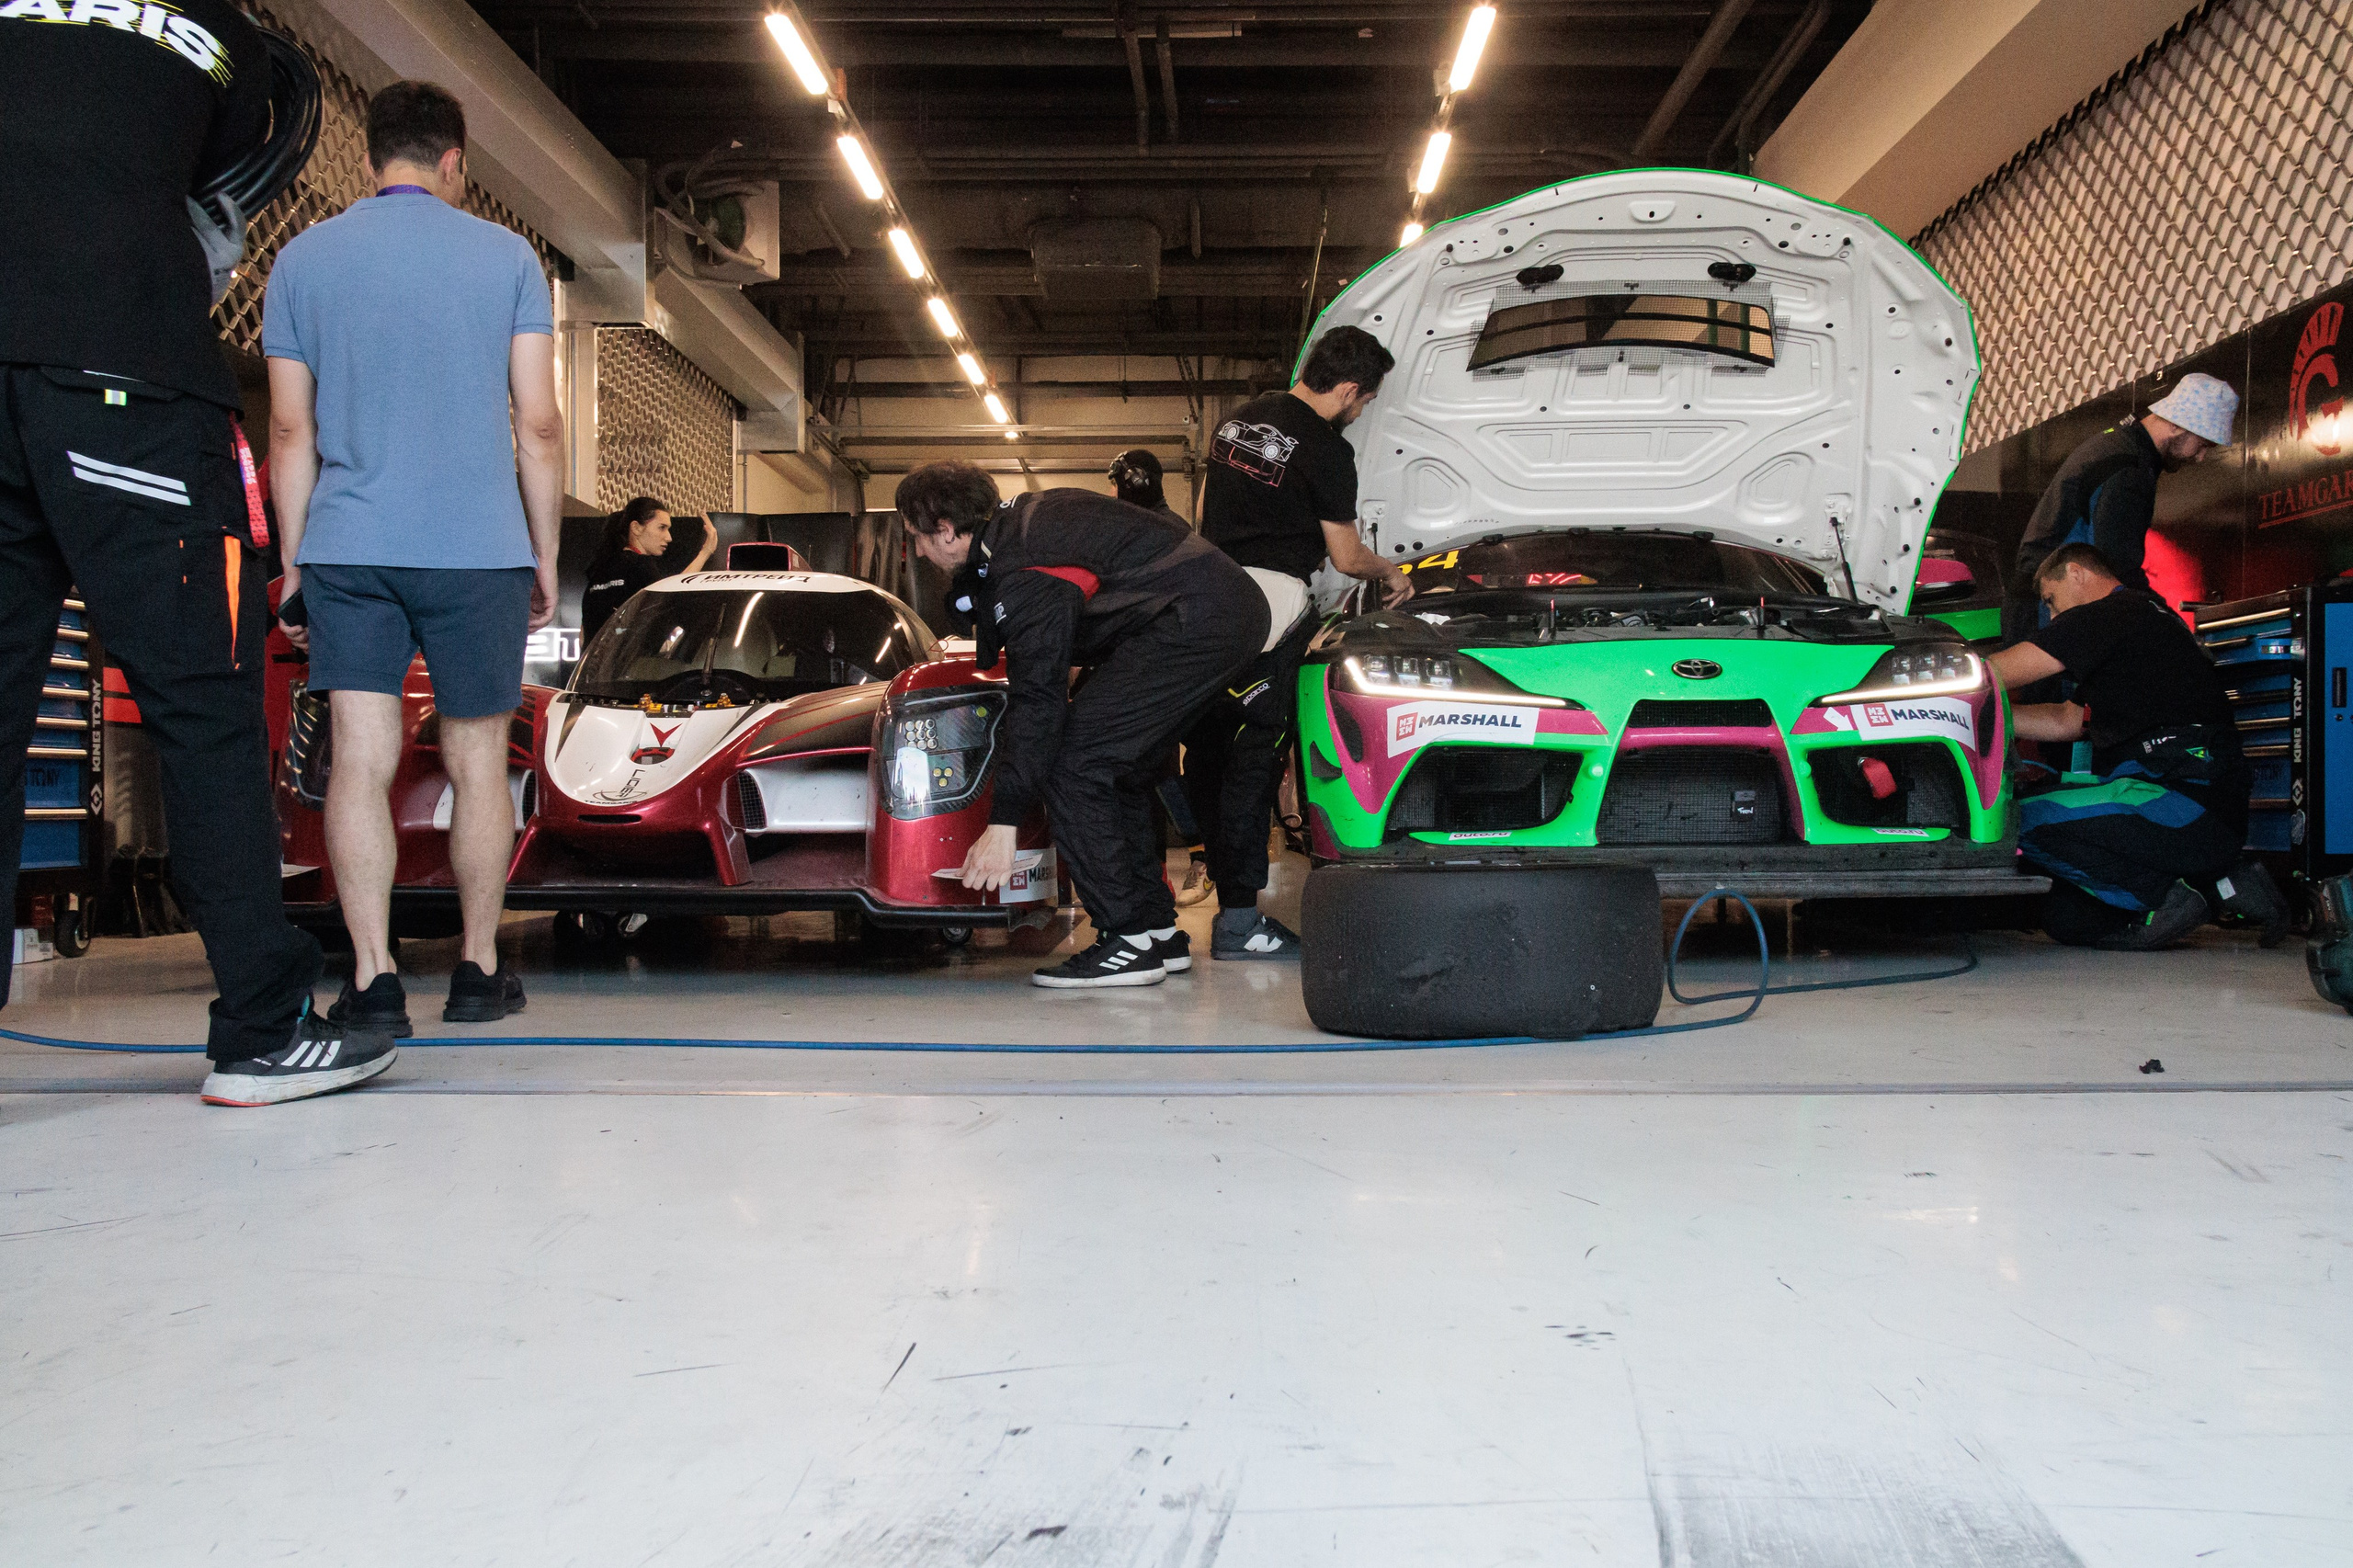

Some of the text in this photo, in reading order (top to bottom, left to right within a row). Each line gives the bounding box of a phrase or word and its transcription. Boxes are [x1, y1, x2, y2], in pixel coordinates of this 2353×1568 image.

[92, 678, 101, 772] KING TONY
[1418, 713, 1522, 729] MARSHALL
[1891, 709, 1970, 731] MARSHALL
[2293, 677, 2302, 763] KING TONY
